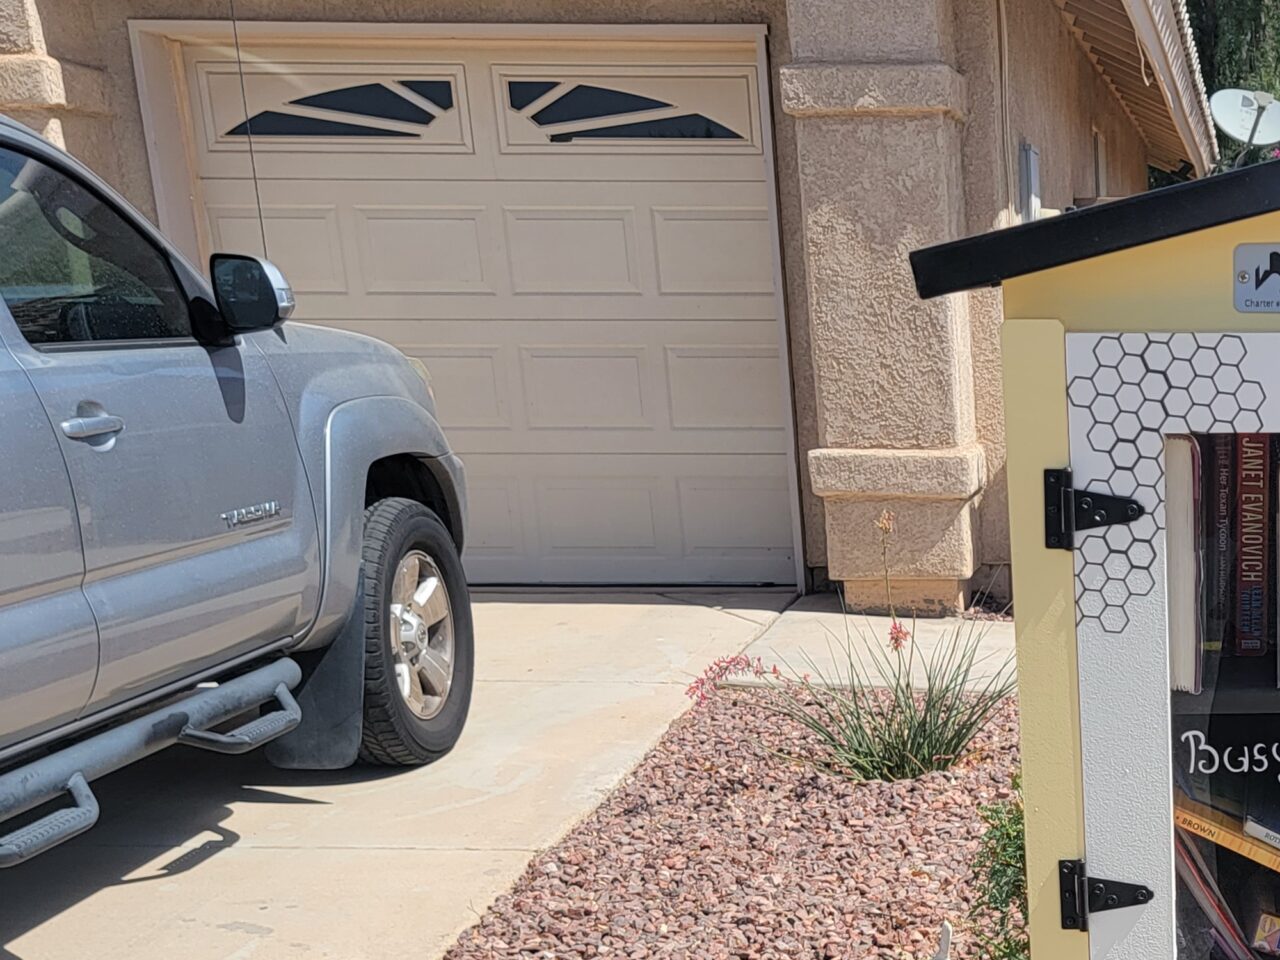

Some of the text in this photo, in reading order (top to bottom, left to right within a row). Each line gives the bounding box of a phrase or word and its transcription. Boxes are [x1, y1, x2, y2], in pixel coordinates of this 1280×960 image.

[1244, 299, 1274, 308] Charter
[1241, 437, 1264, 582] JANET EVANOVICH
[1181, 817, 1216, 839] BROWN
